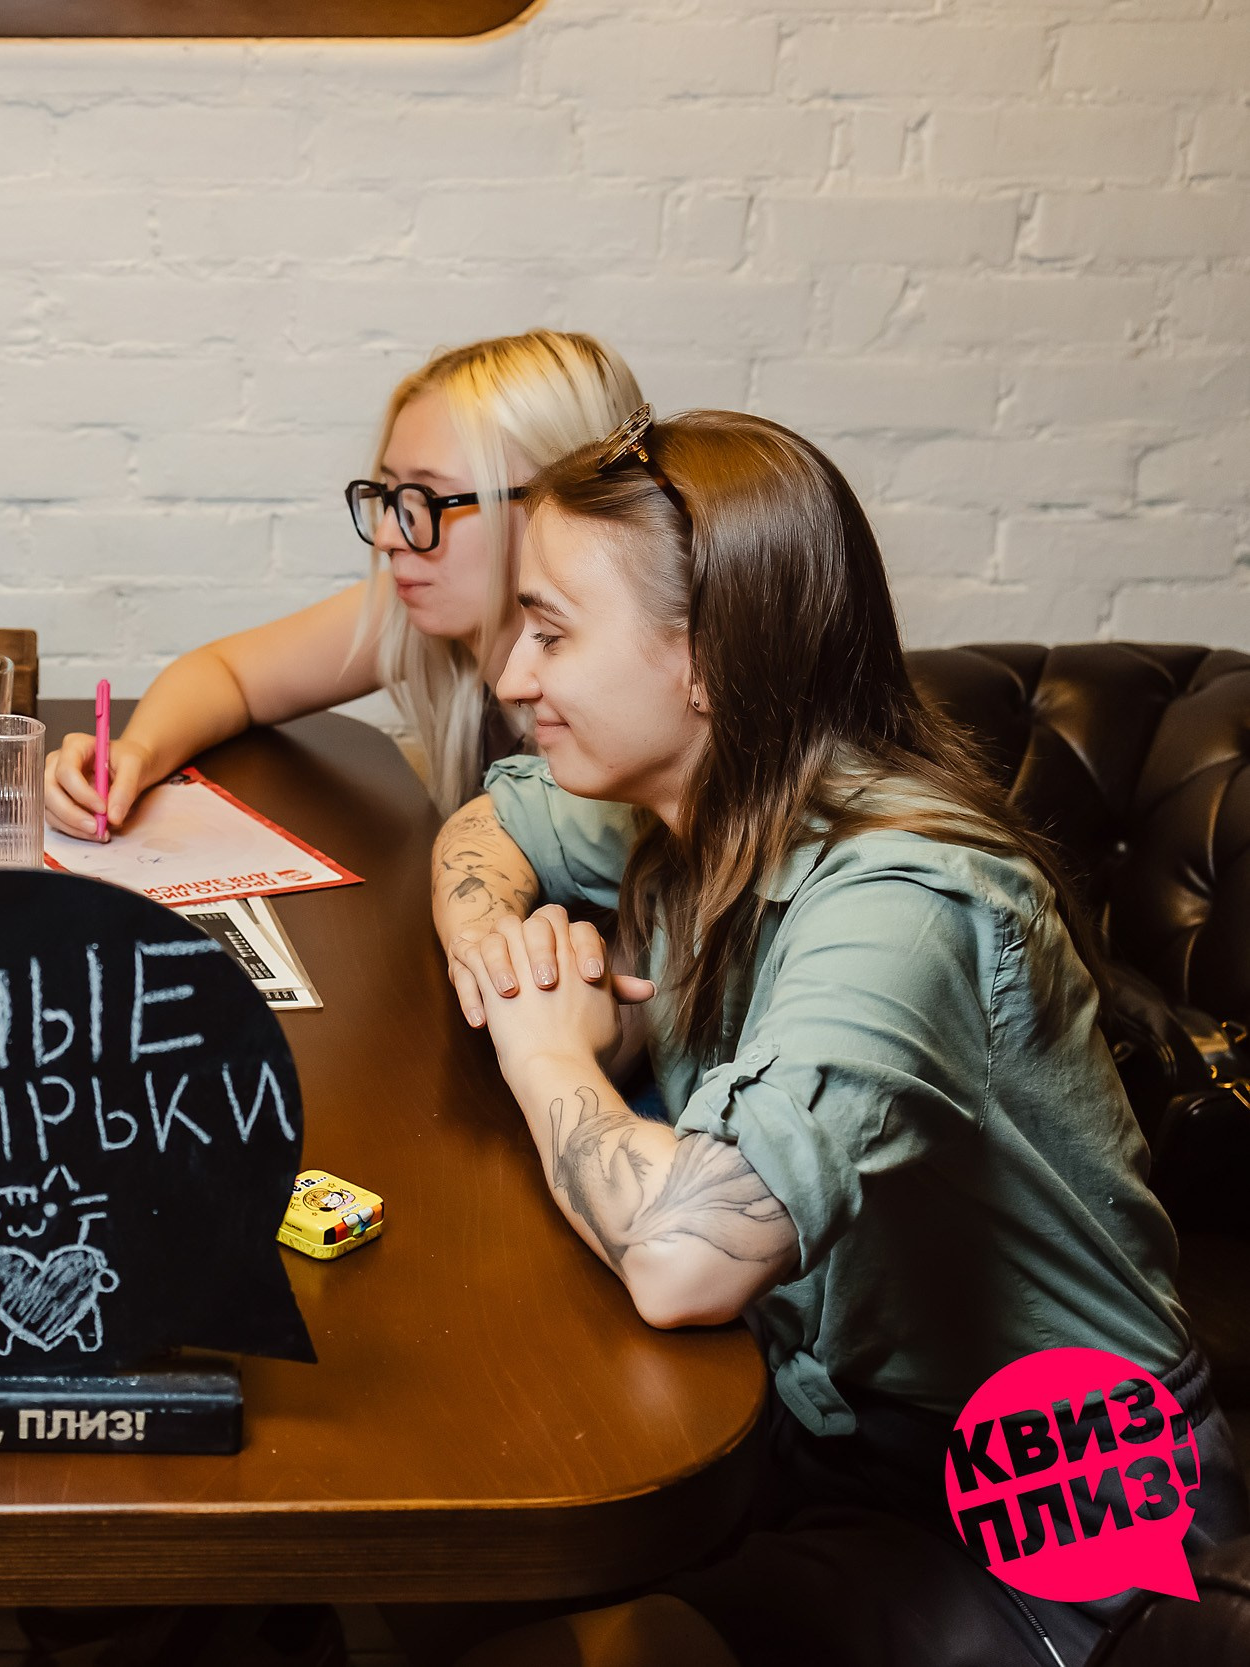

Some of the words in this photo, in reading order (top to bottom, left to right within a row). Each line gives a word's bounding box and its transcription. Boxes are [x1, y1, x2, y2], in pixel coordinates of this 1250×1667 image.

[227, 871, 270, 884] ДЛЯ
[143, 878, 221, 895] ЗАПИСИ
[149, 889, 191, 901] ЛИС
[194, 878, 279, 895] ПРОСТО
[18, 1409, 146, 1441] ПЛИЗ!
